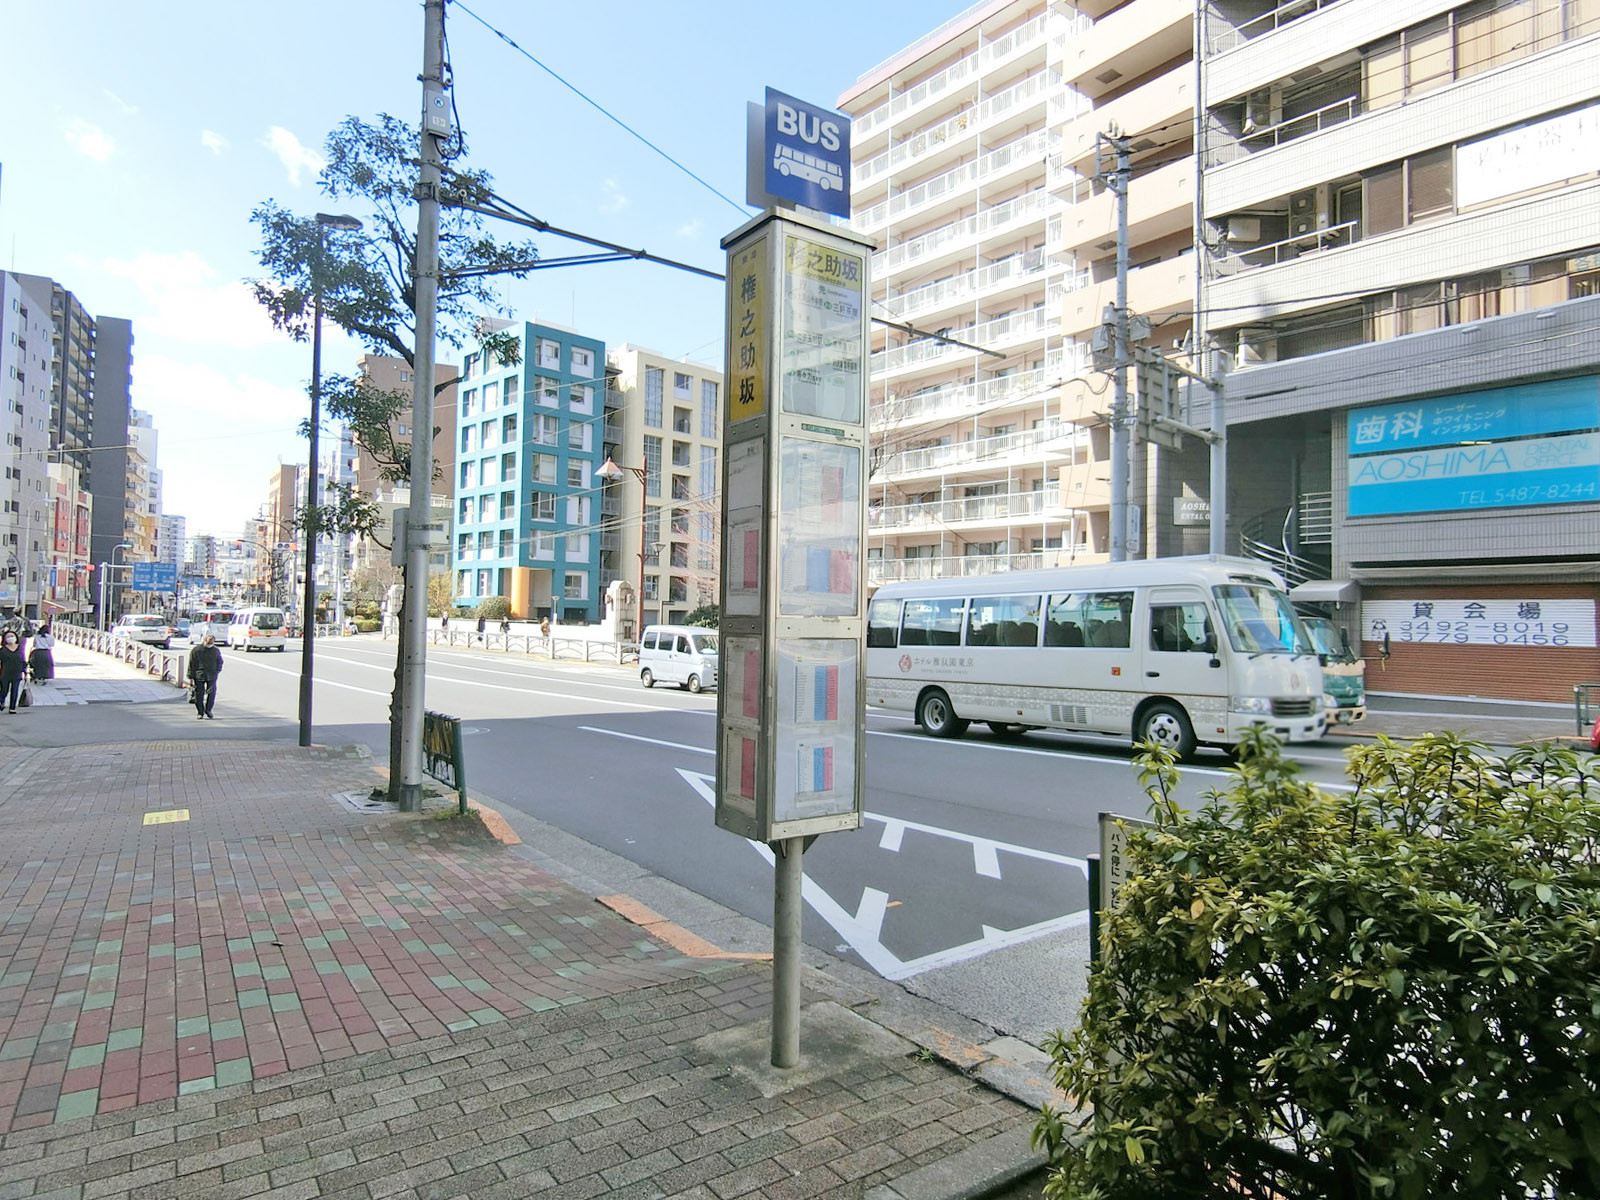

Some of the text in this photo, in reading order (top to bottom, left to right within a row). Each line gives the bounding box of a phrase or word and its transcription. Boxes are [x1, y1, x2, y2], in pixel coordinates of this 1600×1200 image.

[776, 102, 840, 152] BUS
[739, 273, 757, 405] 権之助坂
[1355, 408, 1424, 445] 歯科
[1526, 438, 1590, 456] DENTAL
[1355, 447, 1512, 483] AOSHIMA
[1181, 503, 1210, 511] AOSHI
[1412, 602, 1542, 620] 貸会場
[1399, 621, 1569, 633] 3492-8019
[1399, 632, 1569, 646] 3779-0456
